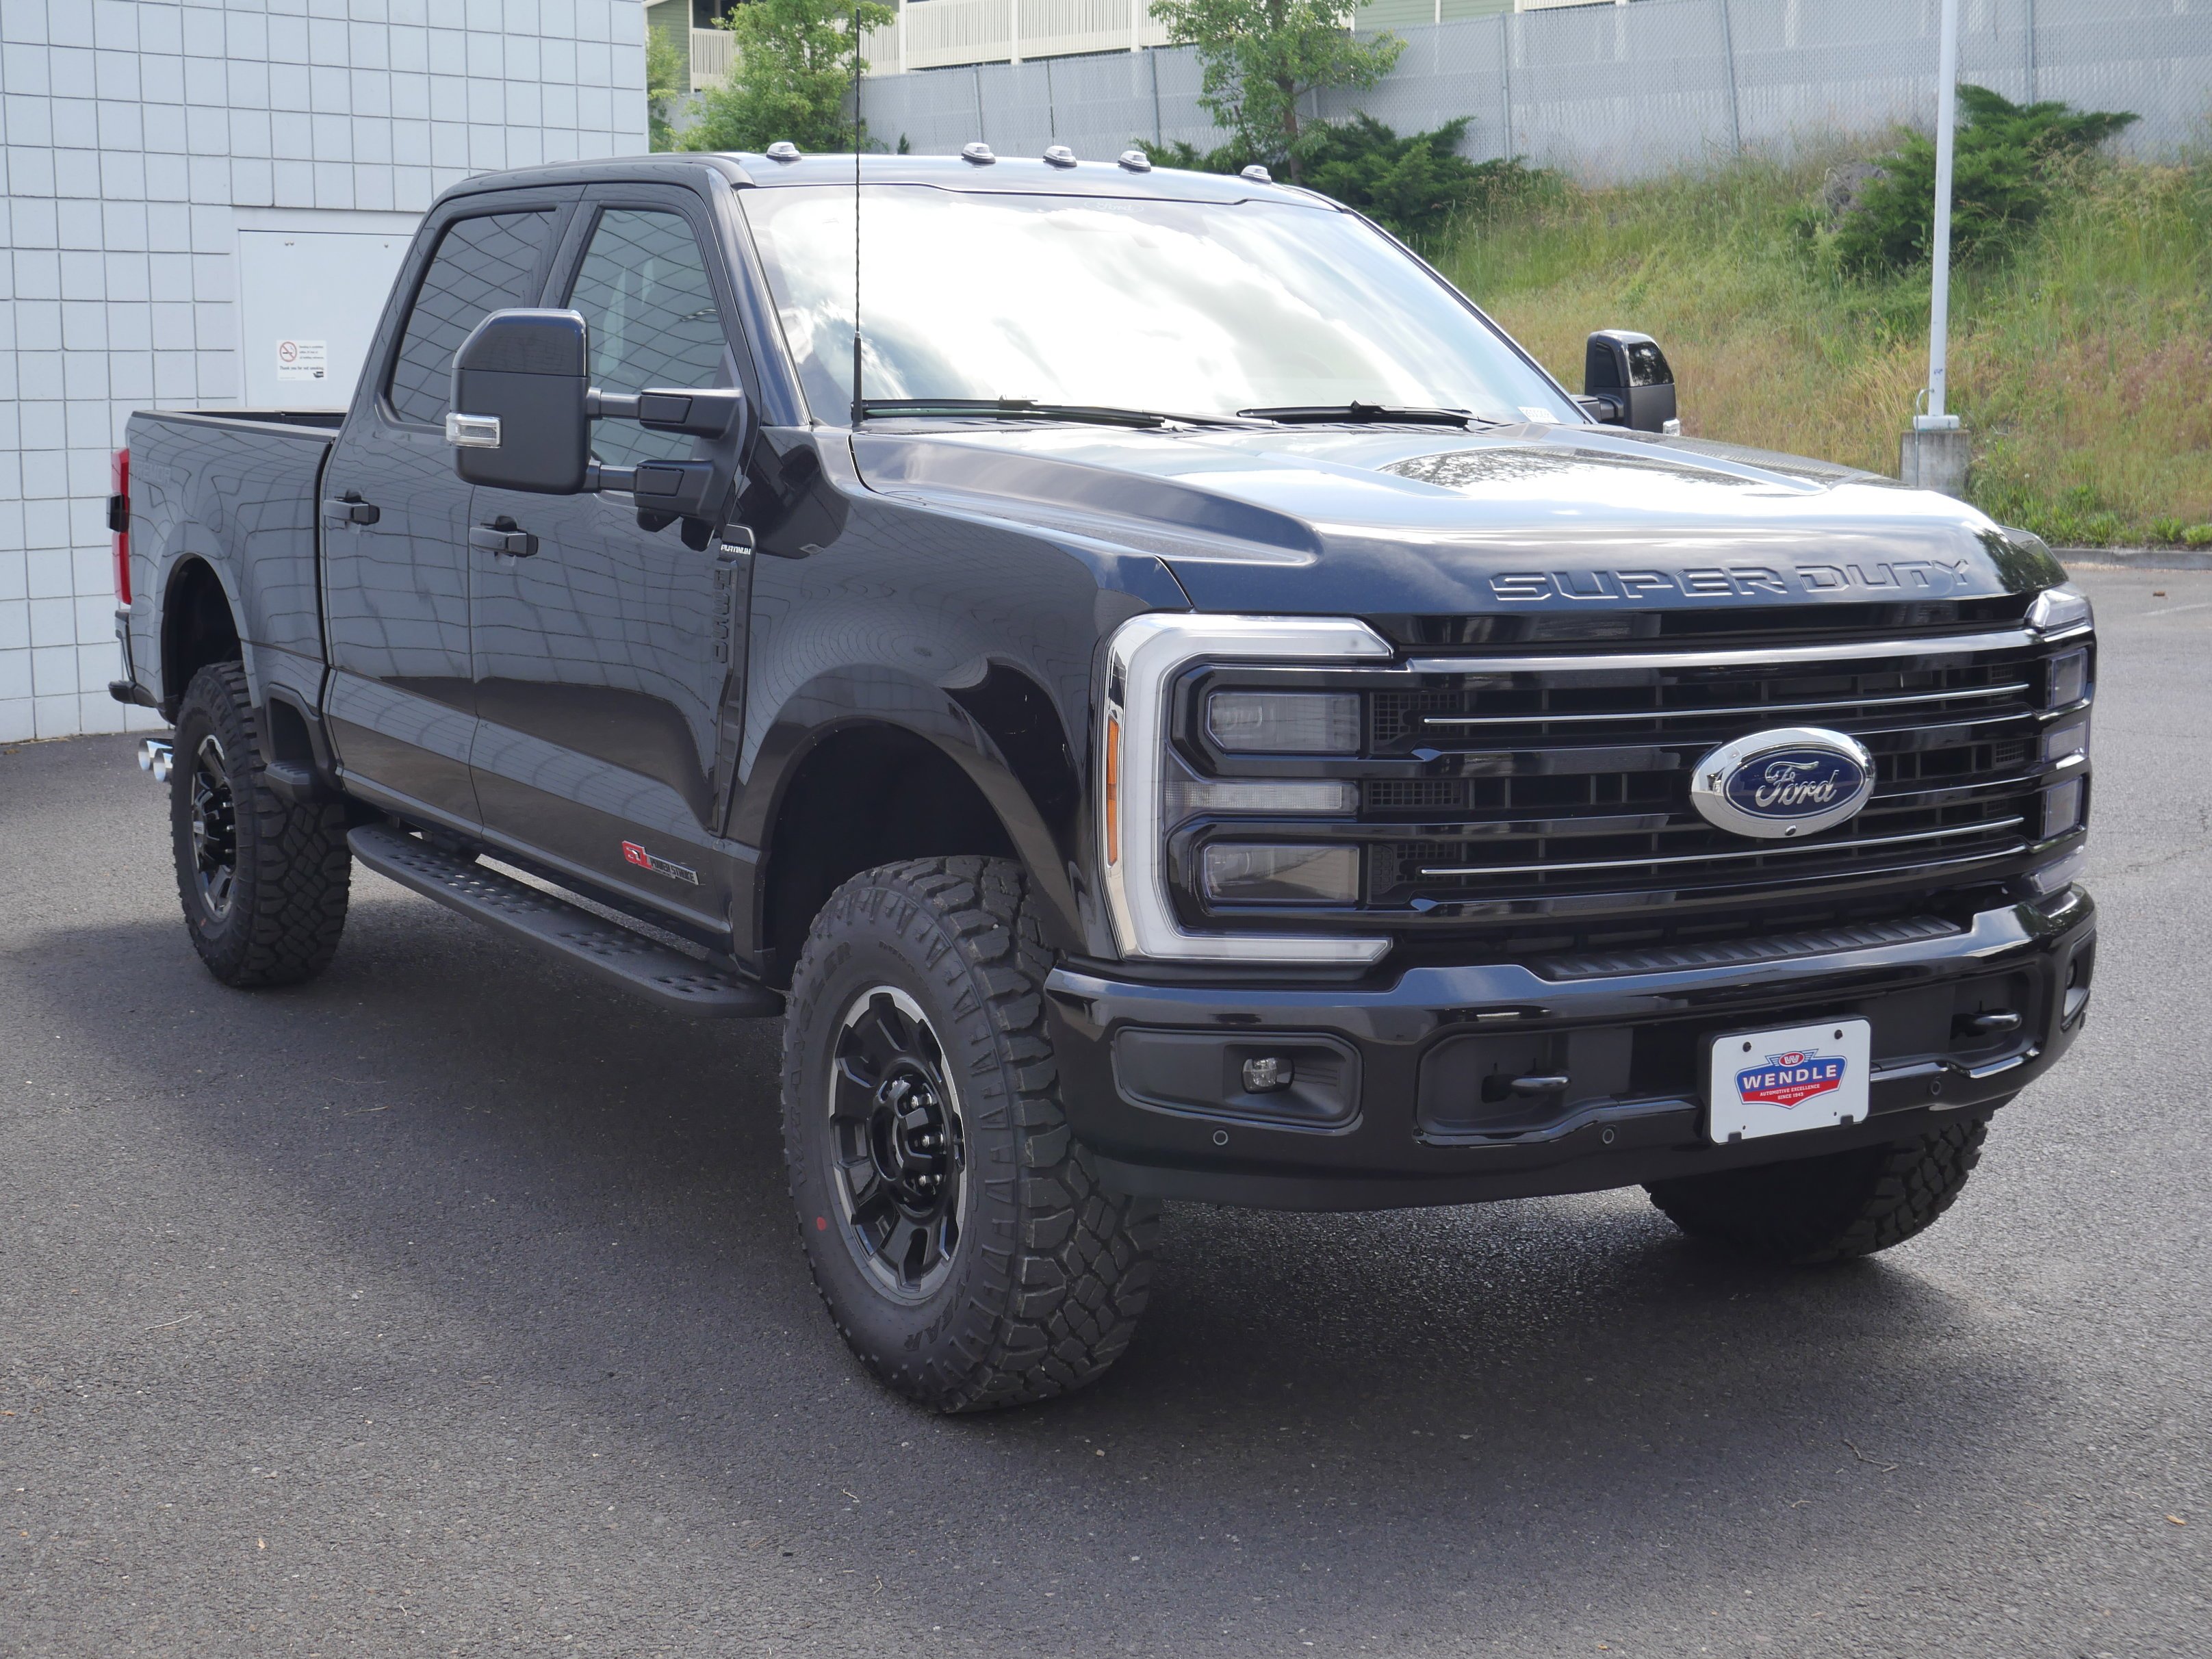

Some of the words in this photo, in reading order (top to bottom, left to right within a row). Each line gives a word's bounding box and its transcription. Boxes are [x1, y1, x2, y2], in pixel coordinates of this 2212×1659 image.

[1096, 201, 1133, 211] Ford
[721, 544, 751, 555] PLATINUM
[1490, 566, 1788, 601] SUPER
[1795, 558, 1970, 593] DUTY
[1755, 760, 1840, 807] Ford
[1742, 1064, 1837, 1089] WENDLE
[1760, 1088, 1790, 1097] AUTOMOTIVE
[1790, 1083, 1821, 1094] EXCELLENCE
